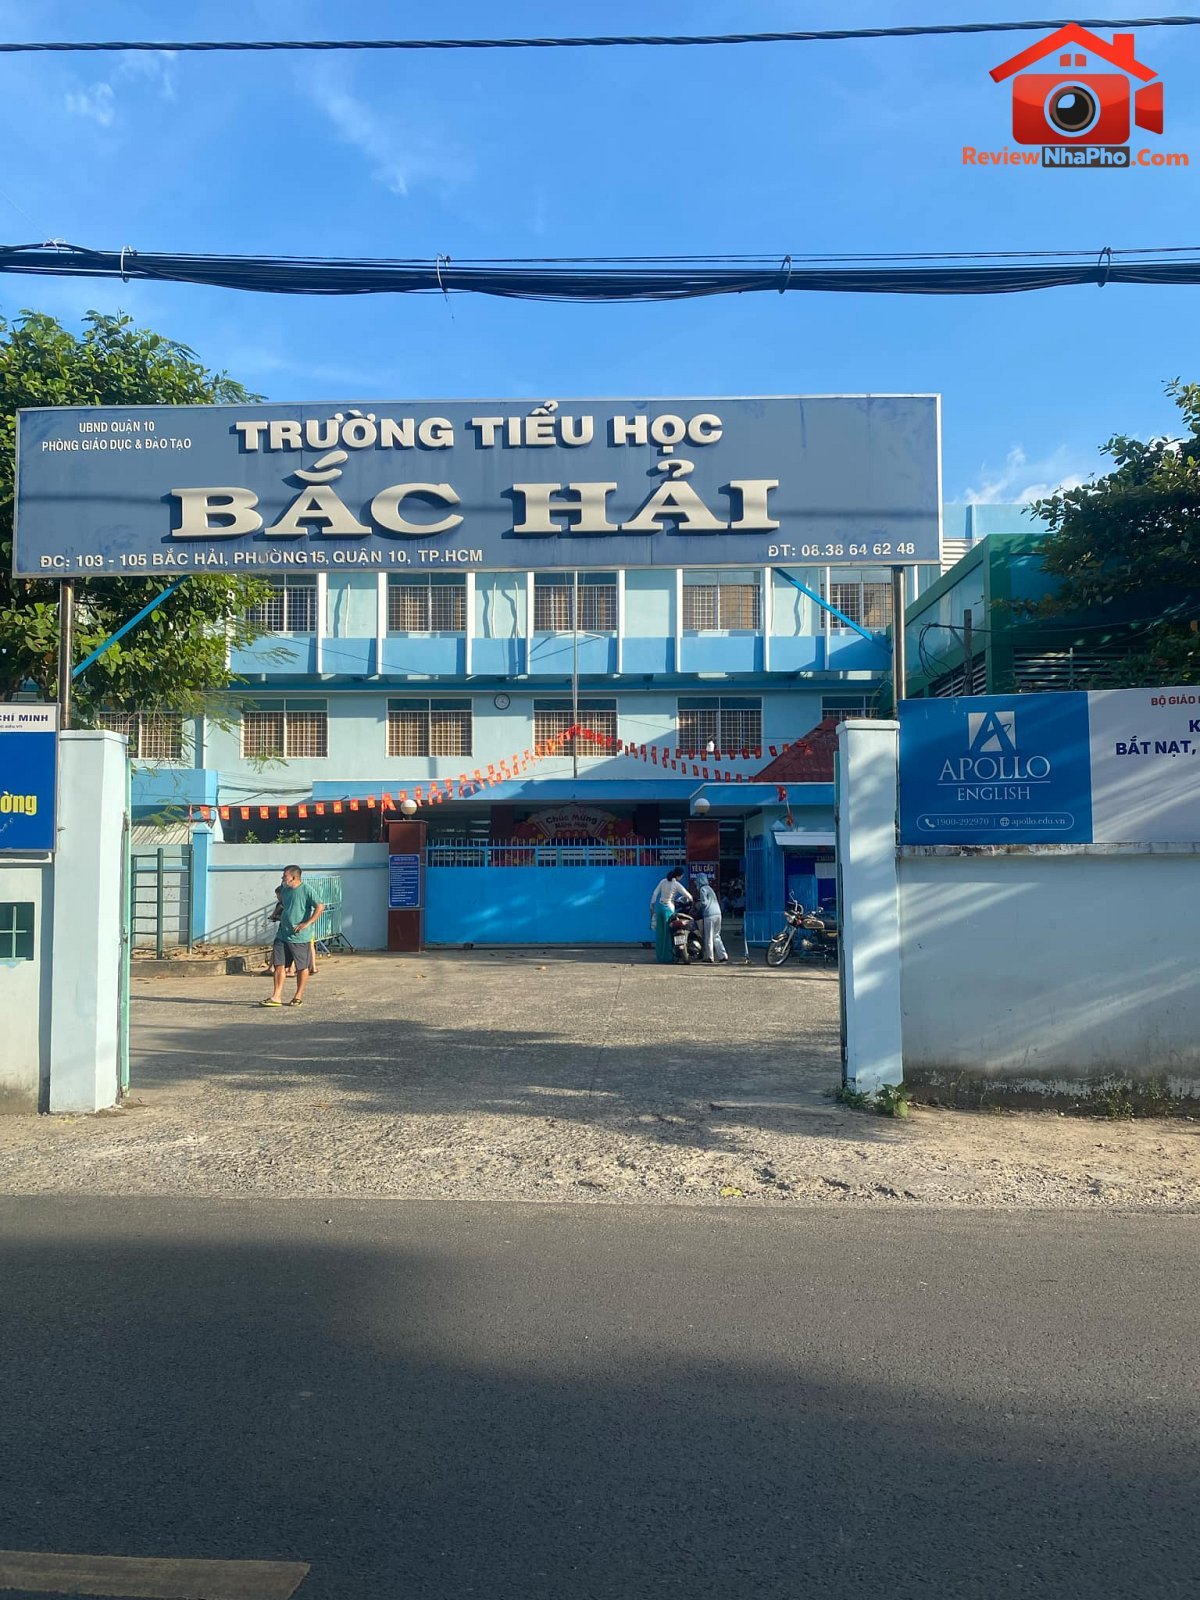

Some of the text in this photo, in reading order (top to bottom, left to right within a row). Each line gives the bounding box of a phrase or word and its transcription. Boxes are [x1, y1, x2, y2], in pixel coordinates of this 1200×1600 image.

[79, 418, 155, 435] UBND QUẬN 10
[235, 400, 723, 454] TRƯỜNG TIỂU HỌC
[42, 436, 192, 452] PHÒNG GIÁO DỤC & ĐÀO TẠO
[170, 450, 780, 537] BẮC HẢI
[40, 555, 70, 567] ĐC:
[76, 555, 104, 567] 103
[120, 554, 147, 566] 105
[152, 548, 189, 565] BẮC
[194, 548, 229, 566] HẢI,
[332, 548, 382, 566] QUẬN
[389, 550, 411, 564] 10,
[418, 549, 483, 563] TP.HCM
[768, 542, 915, 557] ĐT: 08.38 64 62 48
[1151, 693, 1196, 708] BỘ GIÁO
[0, 712, 49, 722] HÍ MINH
[1115, 735, 1197, 758] BẮT NẠT,
[938, 755, 1051, 781] APOLLO
[957, 786, 1031, 801] ENGLISH
[0, 790, 38, 816] ờng
[1011, 816, 1066, 828] apollo.edu.vn
